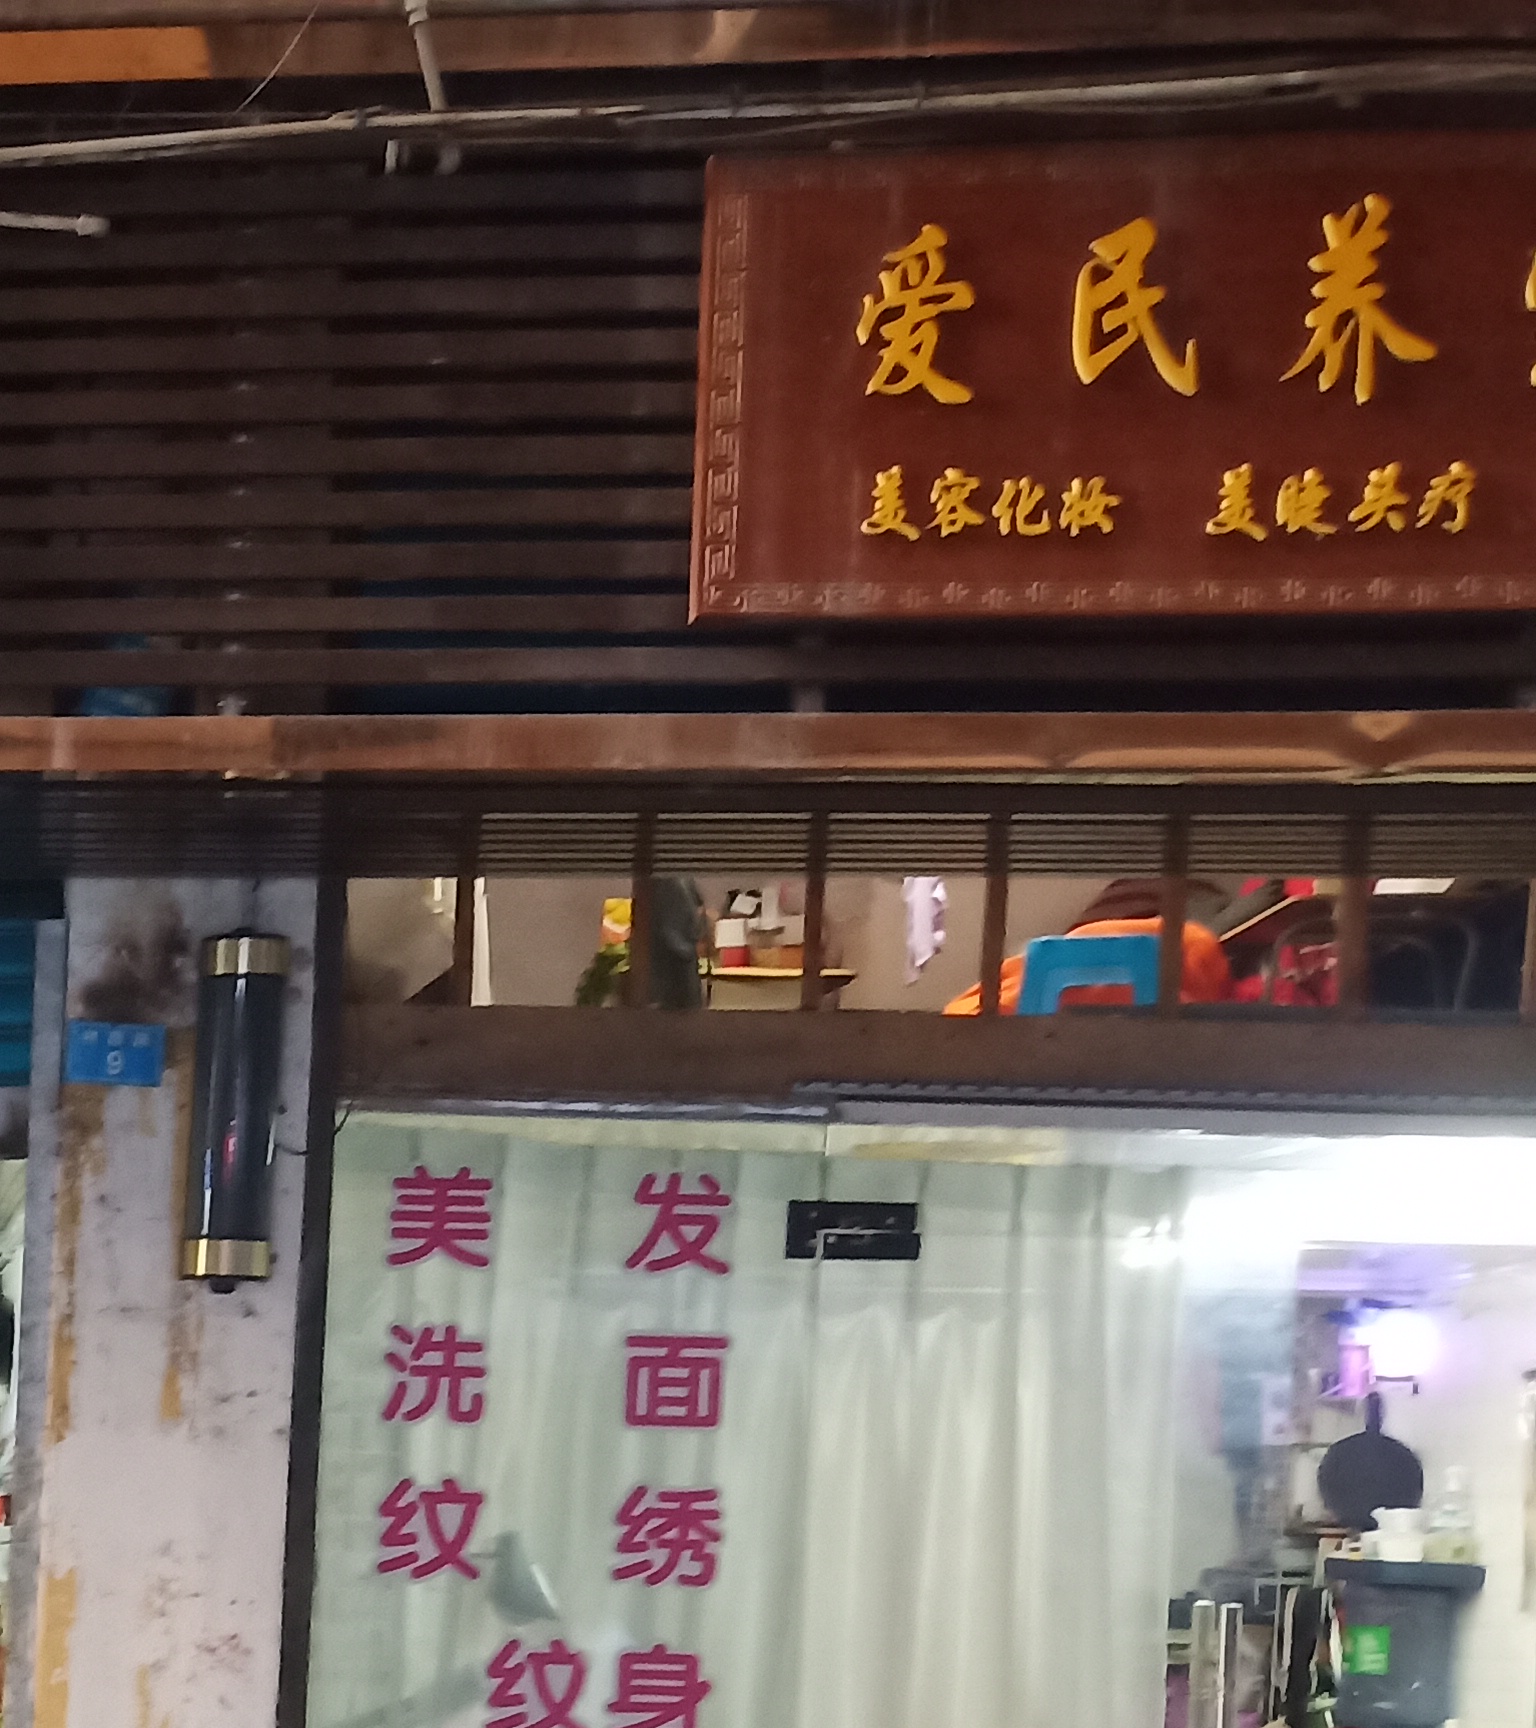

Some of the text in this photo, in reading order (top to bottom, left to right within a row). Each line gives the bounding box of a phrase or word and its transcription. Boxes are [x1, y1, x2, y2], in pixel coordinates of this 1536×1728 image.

[855, 193, 1536, 405] 爱民养
[859, 465, 1122, 542] 美容化妆
